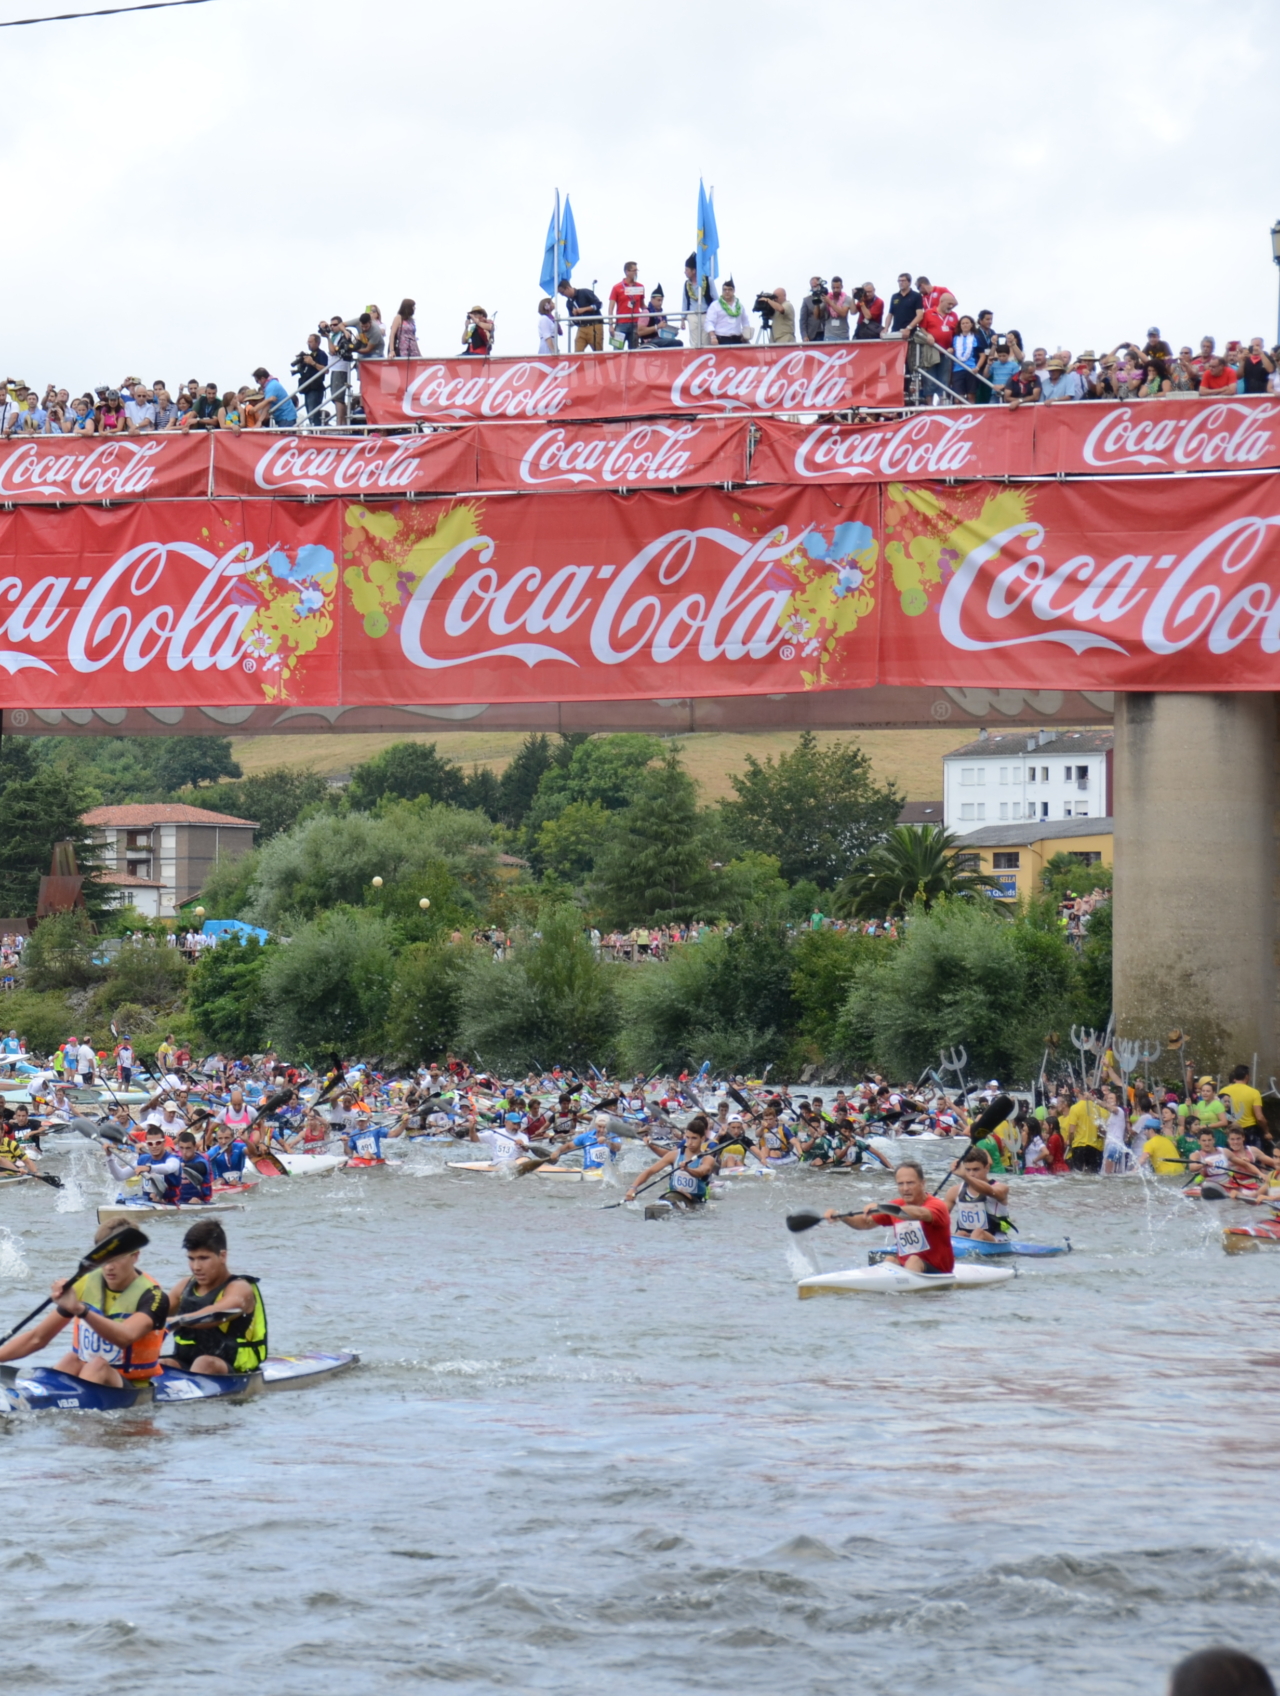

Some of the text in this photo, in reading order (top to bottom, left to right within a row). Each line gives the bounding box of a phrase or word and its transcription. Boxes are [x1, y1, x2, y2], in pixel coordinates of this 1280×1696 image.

[402, 359, 580, 419] Coca-Cola
[671, 347, 859, 412] Coca-Cola
[254, 435, 429, 490] Coca-Cola
[520, 422, 704, 484] Coca-Cola
[794, 414, 985, 477] Coca-Cola
[1082, 403, 1280, 466] Coca-Cola
[399, 522, 816, 669] Coca-Cola
[993, 889, 1016, 897] Quds
[497, 1146, 511, 1154] 513
[677, 1175, 694, 1189] 630
[899, 1230, 920, 1248] 503
[961, 1210, 980, 1224] 661
